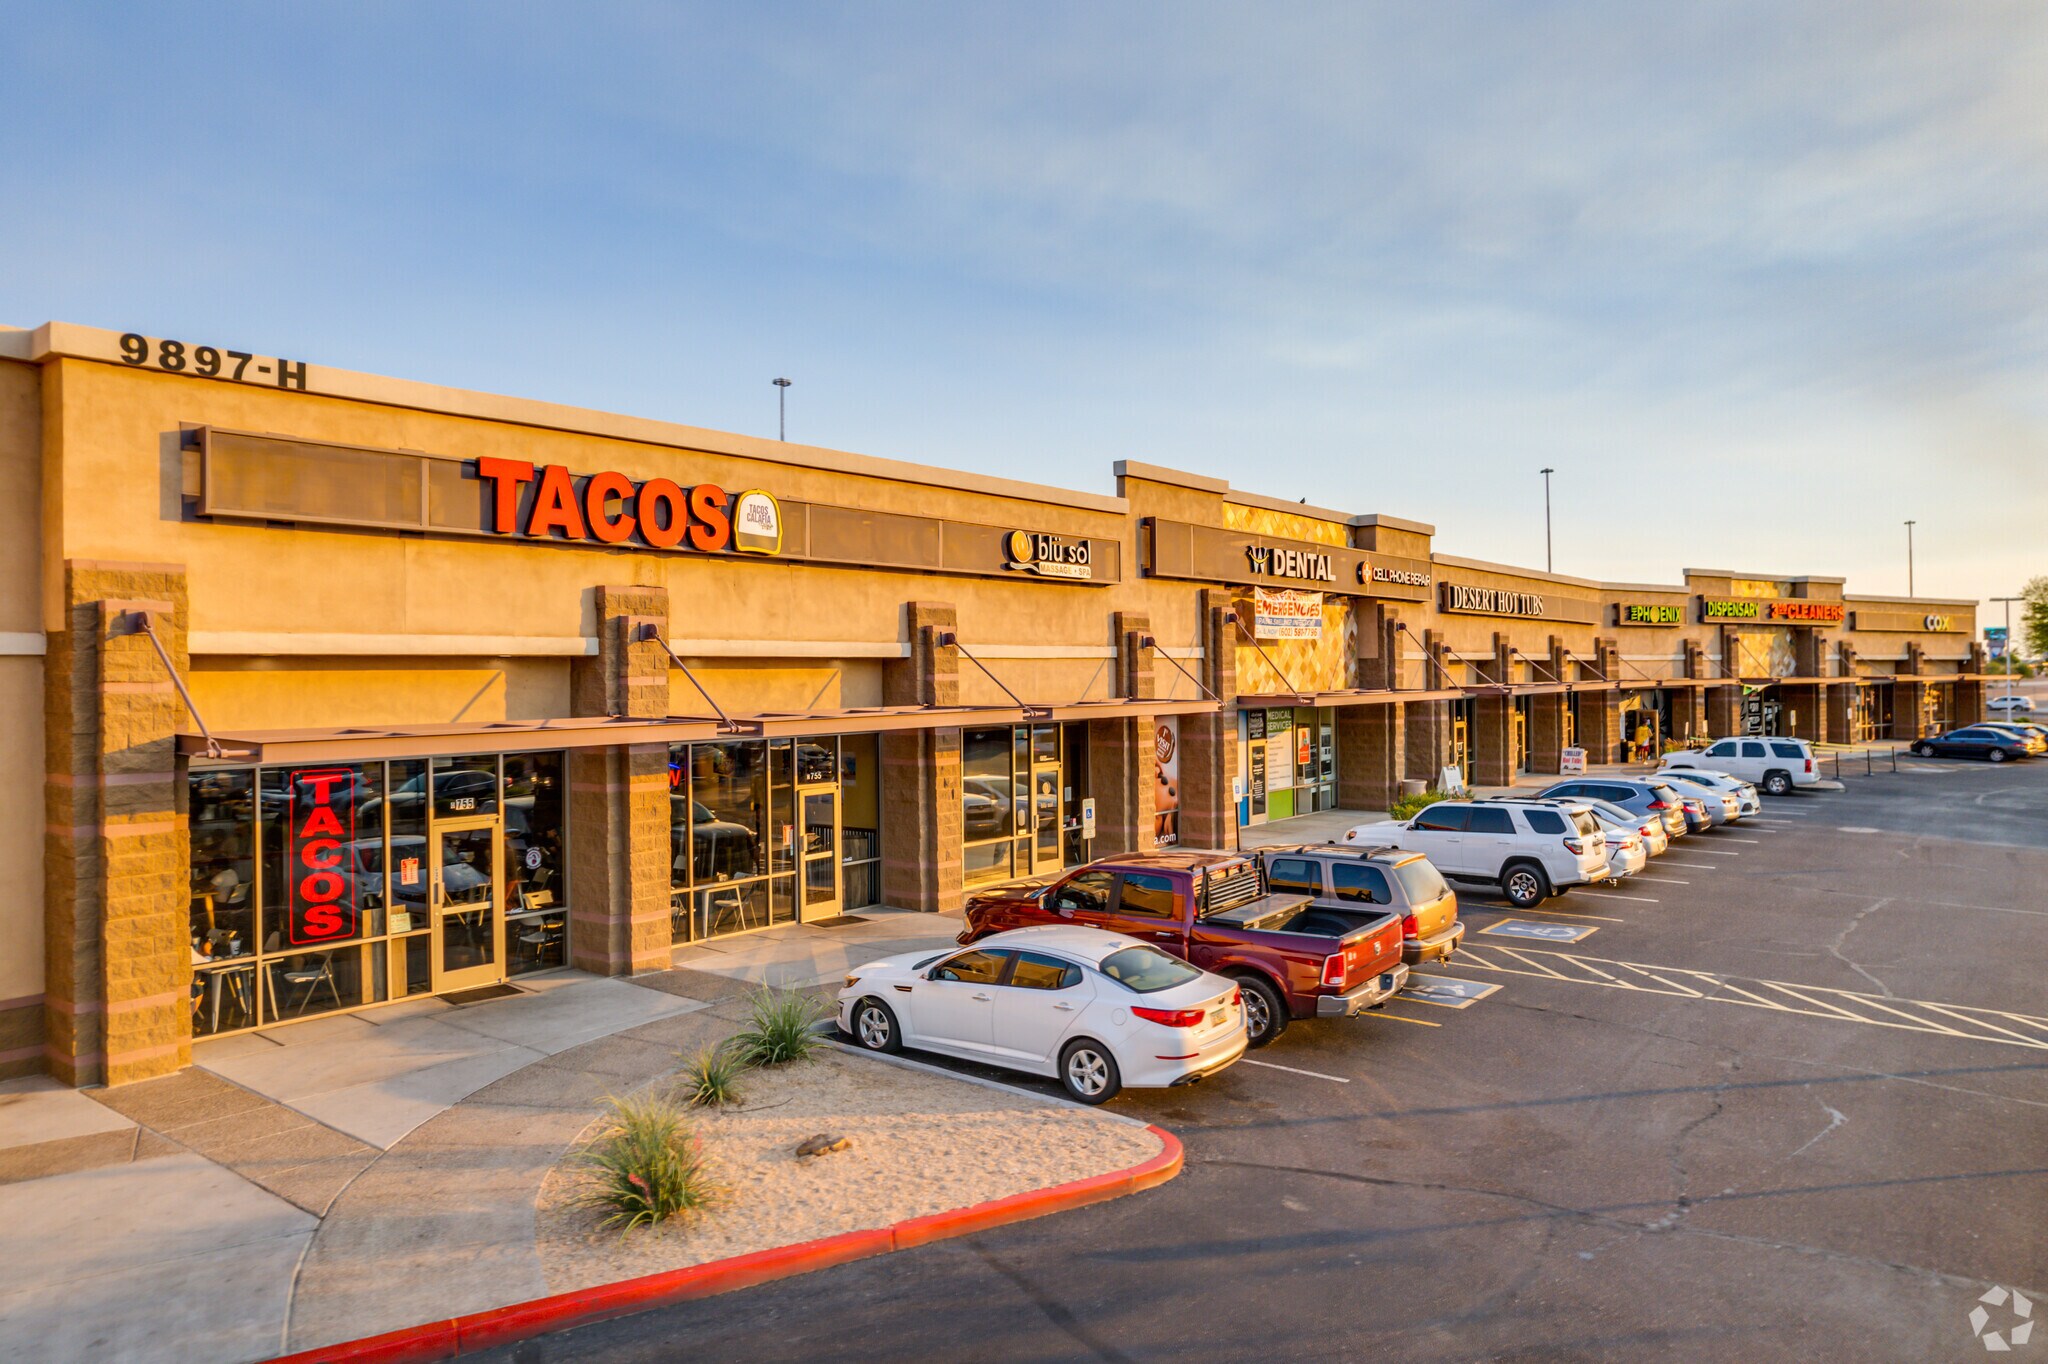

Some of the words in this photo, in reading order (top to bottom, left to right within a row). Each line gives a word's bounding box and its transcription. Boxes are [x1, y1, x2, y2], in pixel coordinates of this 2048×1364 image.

[119, 333, 306, 390] 9897-H
[476, 456, 730, 550] TACOS
[749, 504, 769, 515] TACOS
[1038, 533, 1063, 562] blü
[1068, 539, 1091, 565] sol
[1040, 563, 1073, 575] MASSAGE
[1078, 567, 1091, 577] SPA
[1273, 548, 1336, 581] DENTAL
[1373, 567, 1389, 581] CELL
[1390, 569, 1411, 584] PHONE
[1411, 572, 1430, 587] REPAIR
[1255, 599, 1320, 617] EMERGENCIES
[1453, 585, 1497, 612] DESERT
[1498, 590, 1520, 614] HOT
[1520, 593, 1544, 616] TUBS
[1707, 601, 1760, 618] DISPENSARY
[1637, 604, 1681, 623] PHOENIX
[1787, 603, 1845, 621] CLEANERS
[1926, 614, 1950, 631] COX
[1279, 627, 1293, 637] (602)
[1267, 710, 1292, 720] MEDICAL
[1266, 720, 1292, 731] SERVICES
[299, 774, 345, 936] TACOS
